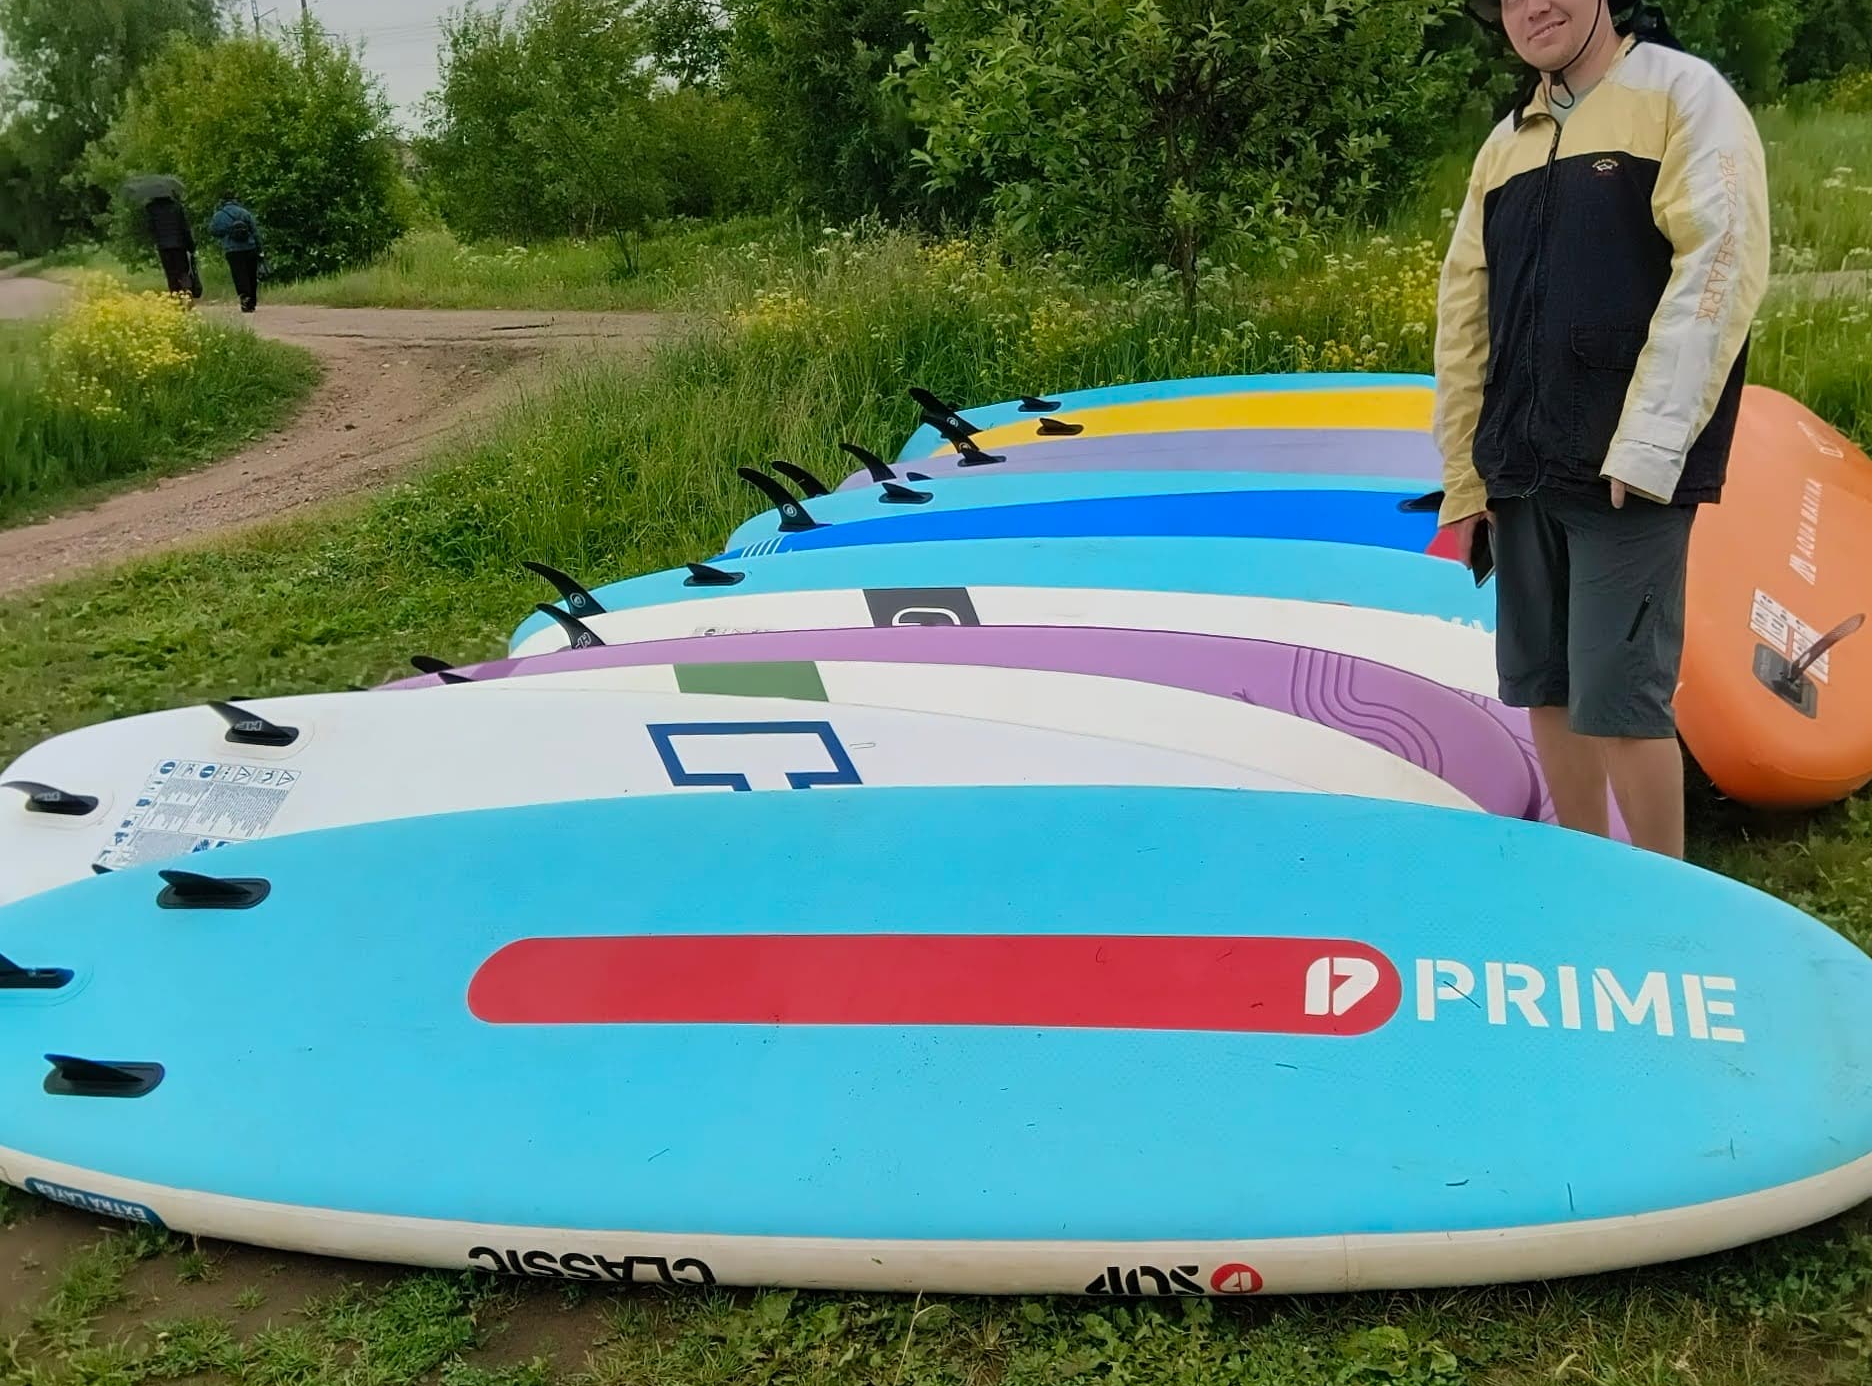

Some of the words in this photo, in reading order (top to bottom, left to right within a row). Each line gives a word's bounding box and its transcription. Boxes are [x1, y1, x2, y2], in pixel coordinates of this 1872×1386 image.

[1695, 231, 1737, 325] SHARK
[1415, 958, 1746, 1043] PRIME
[33, 1181, 87, 1205] LAYER
[88, 1197, 147, 1219] EXTRA
[468, 1246, 717, 1286] CLASSIC
[1084, 1265, 1205, 1295] SUP
